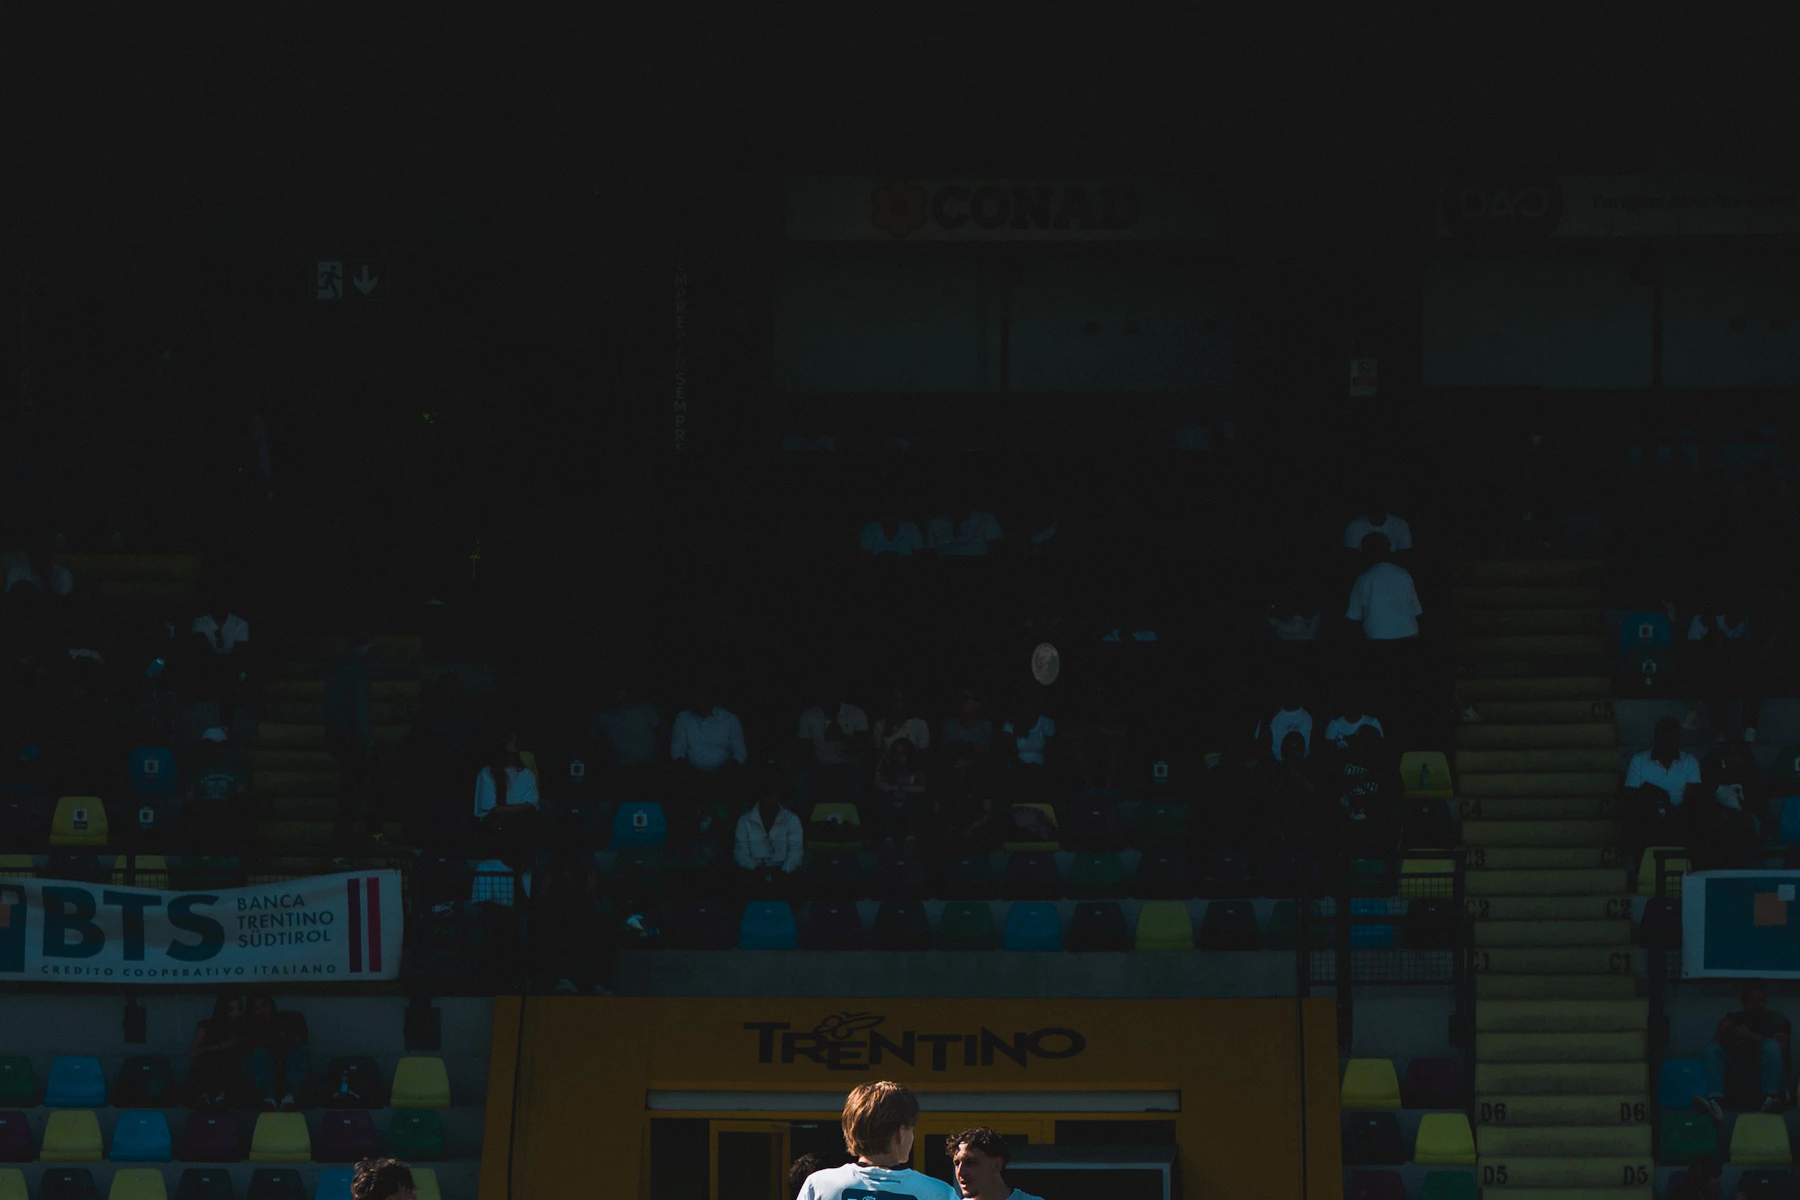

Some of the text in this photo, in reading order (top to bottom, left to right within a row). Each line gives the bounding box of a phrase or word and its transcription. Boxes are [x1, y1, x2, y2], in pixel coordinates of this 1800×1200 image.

[931, 183, 1140, 231] CONAD
[237, 894, 306, 911] BANCA
[42, 885, 226, 961] BTS
[237, 911, 334, 930] TRENTINO
[238, 930, 332, 949] SÜDTIROL
[42, 964, 337, 977] CREDITO COOPERATIVO ITALIANO
[1610, 952, 1632, 970] C1
[744, 1020, 1087, 1072] TRENTINO
[1481, 1102, 1507, 1122] D6
[1620, 1102, 1646, 1122] D6
[1483, 1165, 1508, 1185] D5
[1623, 1165, 1649, 1185] D5
